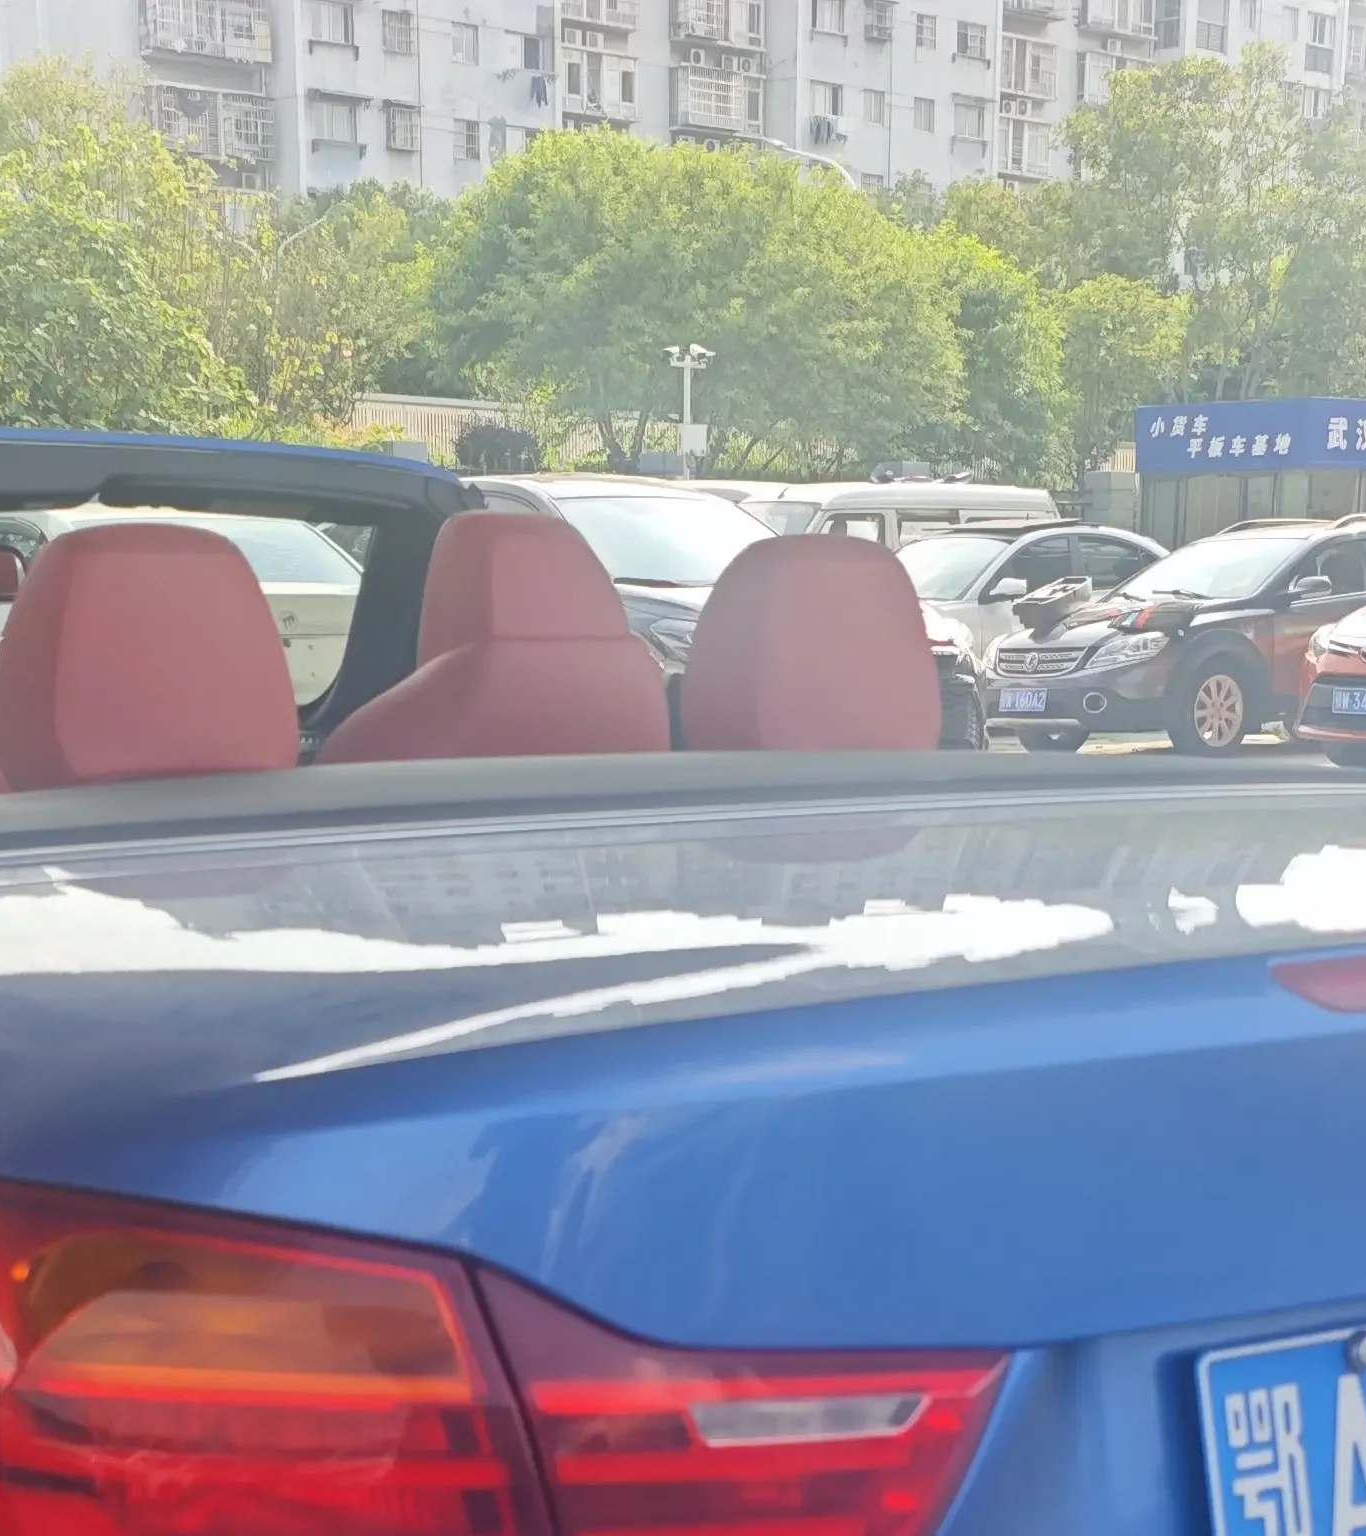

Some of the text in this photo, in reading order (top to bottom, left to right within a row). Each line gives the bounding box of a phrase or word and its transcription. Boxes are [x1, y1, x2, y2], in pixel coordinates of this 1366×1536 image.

[1149, 414, 1209, 438] 小货车
[1187, 432, 1292, 459] 平板车基地
